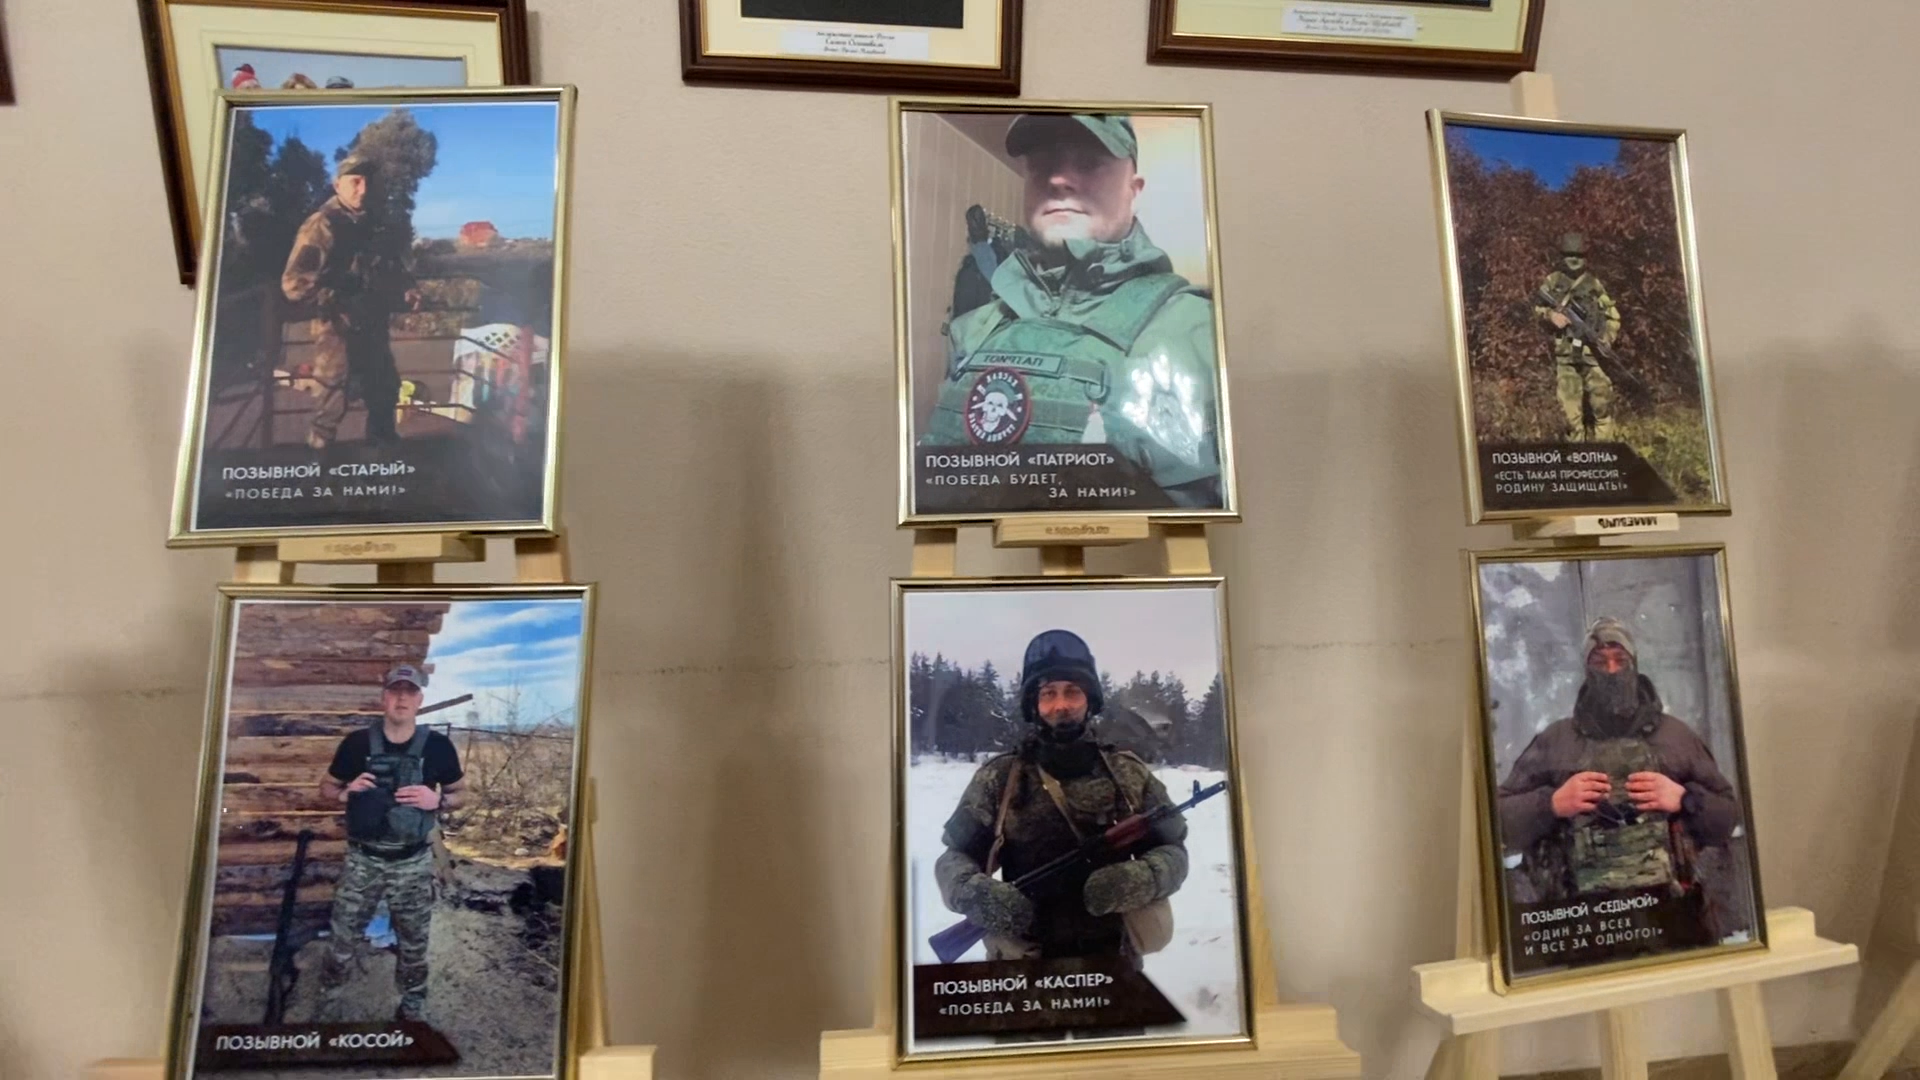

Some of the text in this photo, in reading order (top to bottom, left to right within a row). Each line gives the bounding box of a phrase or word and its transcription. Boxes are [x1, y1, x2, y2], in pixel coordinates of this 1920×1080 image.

[926, 451, 1114, 468] ПОЗЫВНОЙ «ПАТРИОТ»
[1492, 450, 1618, 464] ПОЗЫВНОЙ «ВОЛНА»
[222, 460, 416, 480] ПОЗЫВНОЙ «СТАРЫЙ»
[1494, 471, 1524, 481] «ЕСТЬ
[1526, 470, 1556, 480] ТАКАЯ
[1560, 469, 1619, 479] ПРОФЕССИЯ
[926, 473, 1062, 486] «ПОБЕДА БУДЕТ,
[1496, 482, 1628, 494] РОДИНУ ЗАЩИЩАТЬ!»
[225, 484, 406, 500] «ПОБЕДА ЗА НАМИ!»
[1049, 487, 1136, 498] ЗА НАМИ!»
[1521, 893, 1659, 925] ПОЗЫВНОЙ «СЕДЬМОЙ»
[1523, 918, 1631, 941] «ОДИН ЗА ВСЕХ
[1525, 927, 1663, 956] И ВСЕ ЗА ОДНОГО!»
[933, 973, 1114, 995] ПОЗЫВНОЙ «КАСПЕР»
[939, 997, 1111, 1015] «ПОБЕДА ЗА НАМИ!»
[216, 1030, 415, 1050] ПОЗЫВНОЙ «КОСОЙ»
